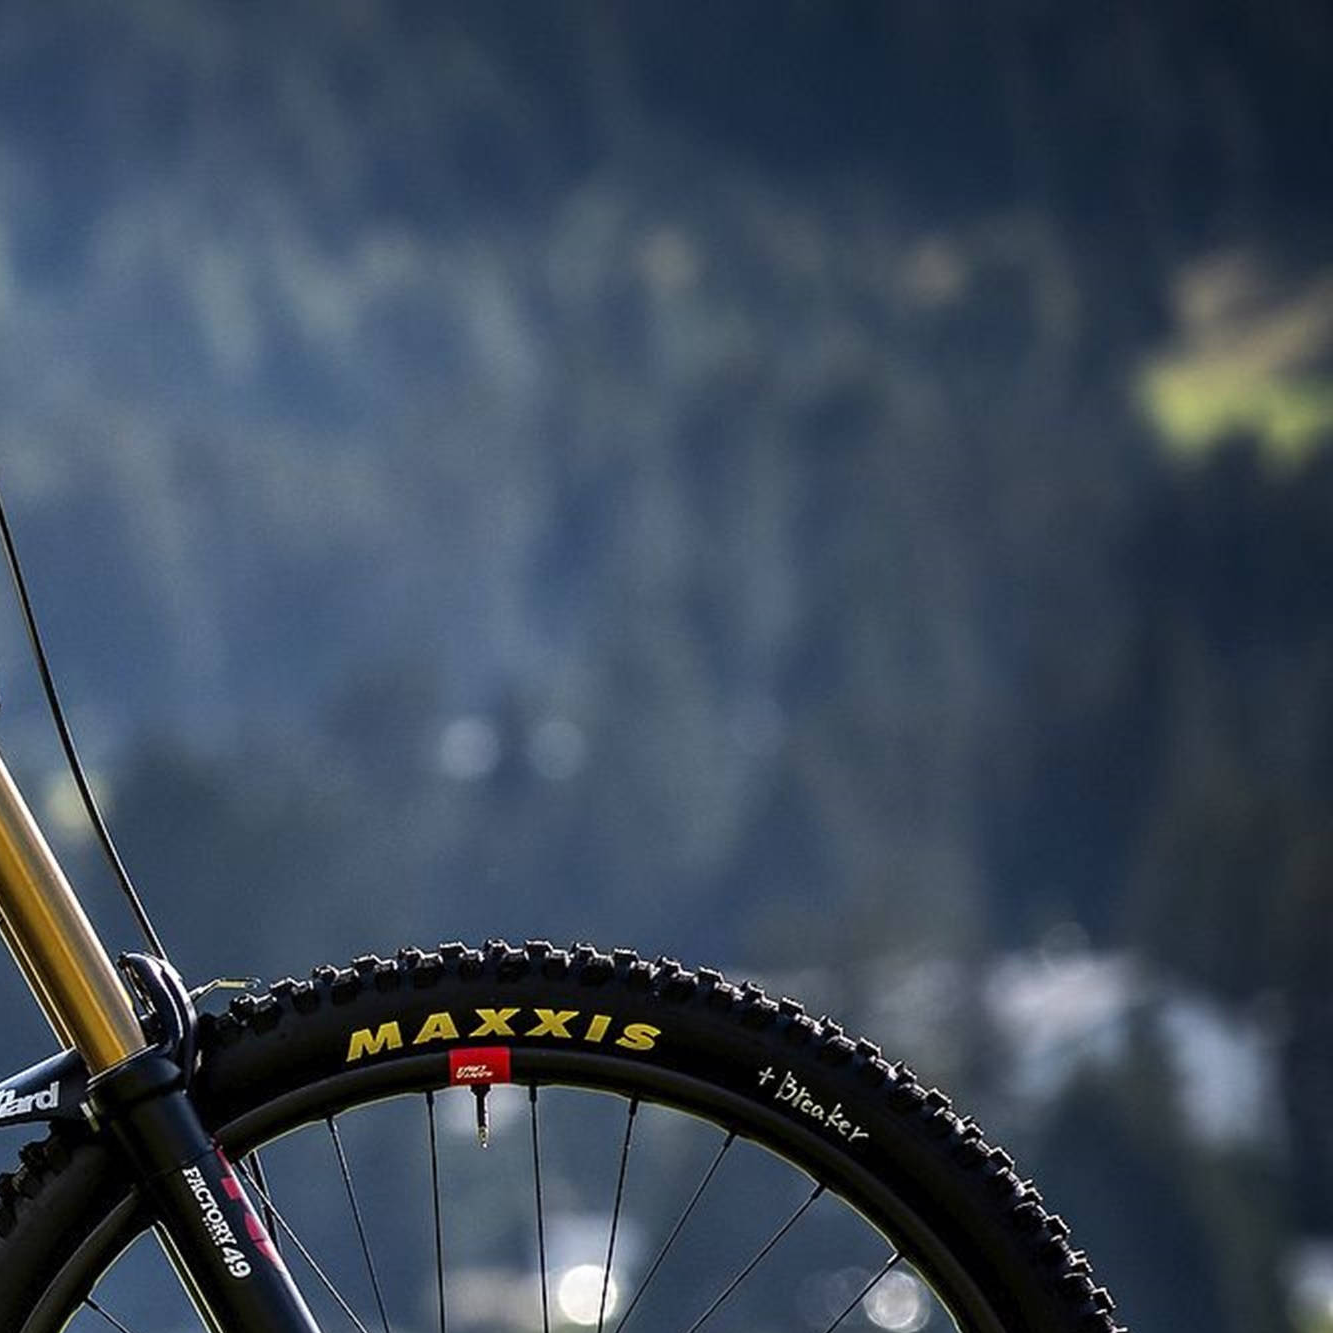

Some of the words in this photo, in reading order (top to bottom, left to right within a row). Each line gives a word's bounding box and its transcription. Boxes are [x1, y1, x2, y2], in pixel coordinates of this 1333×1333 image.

[346, 1007, 662, 1063] MAXXIS
[775, 1069, 870, 1144] Breaker
[182, 1166, 237, 1246] FACTORY
[222, 1247, 252, 1278] 49
